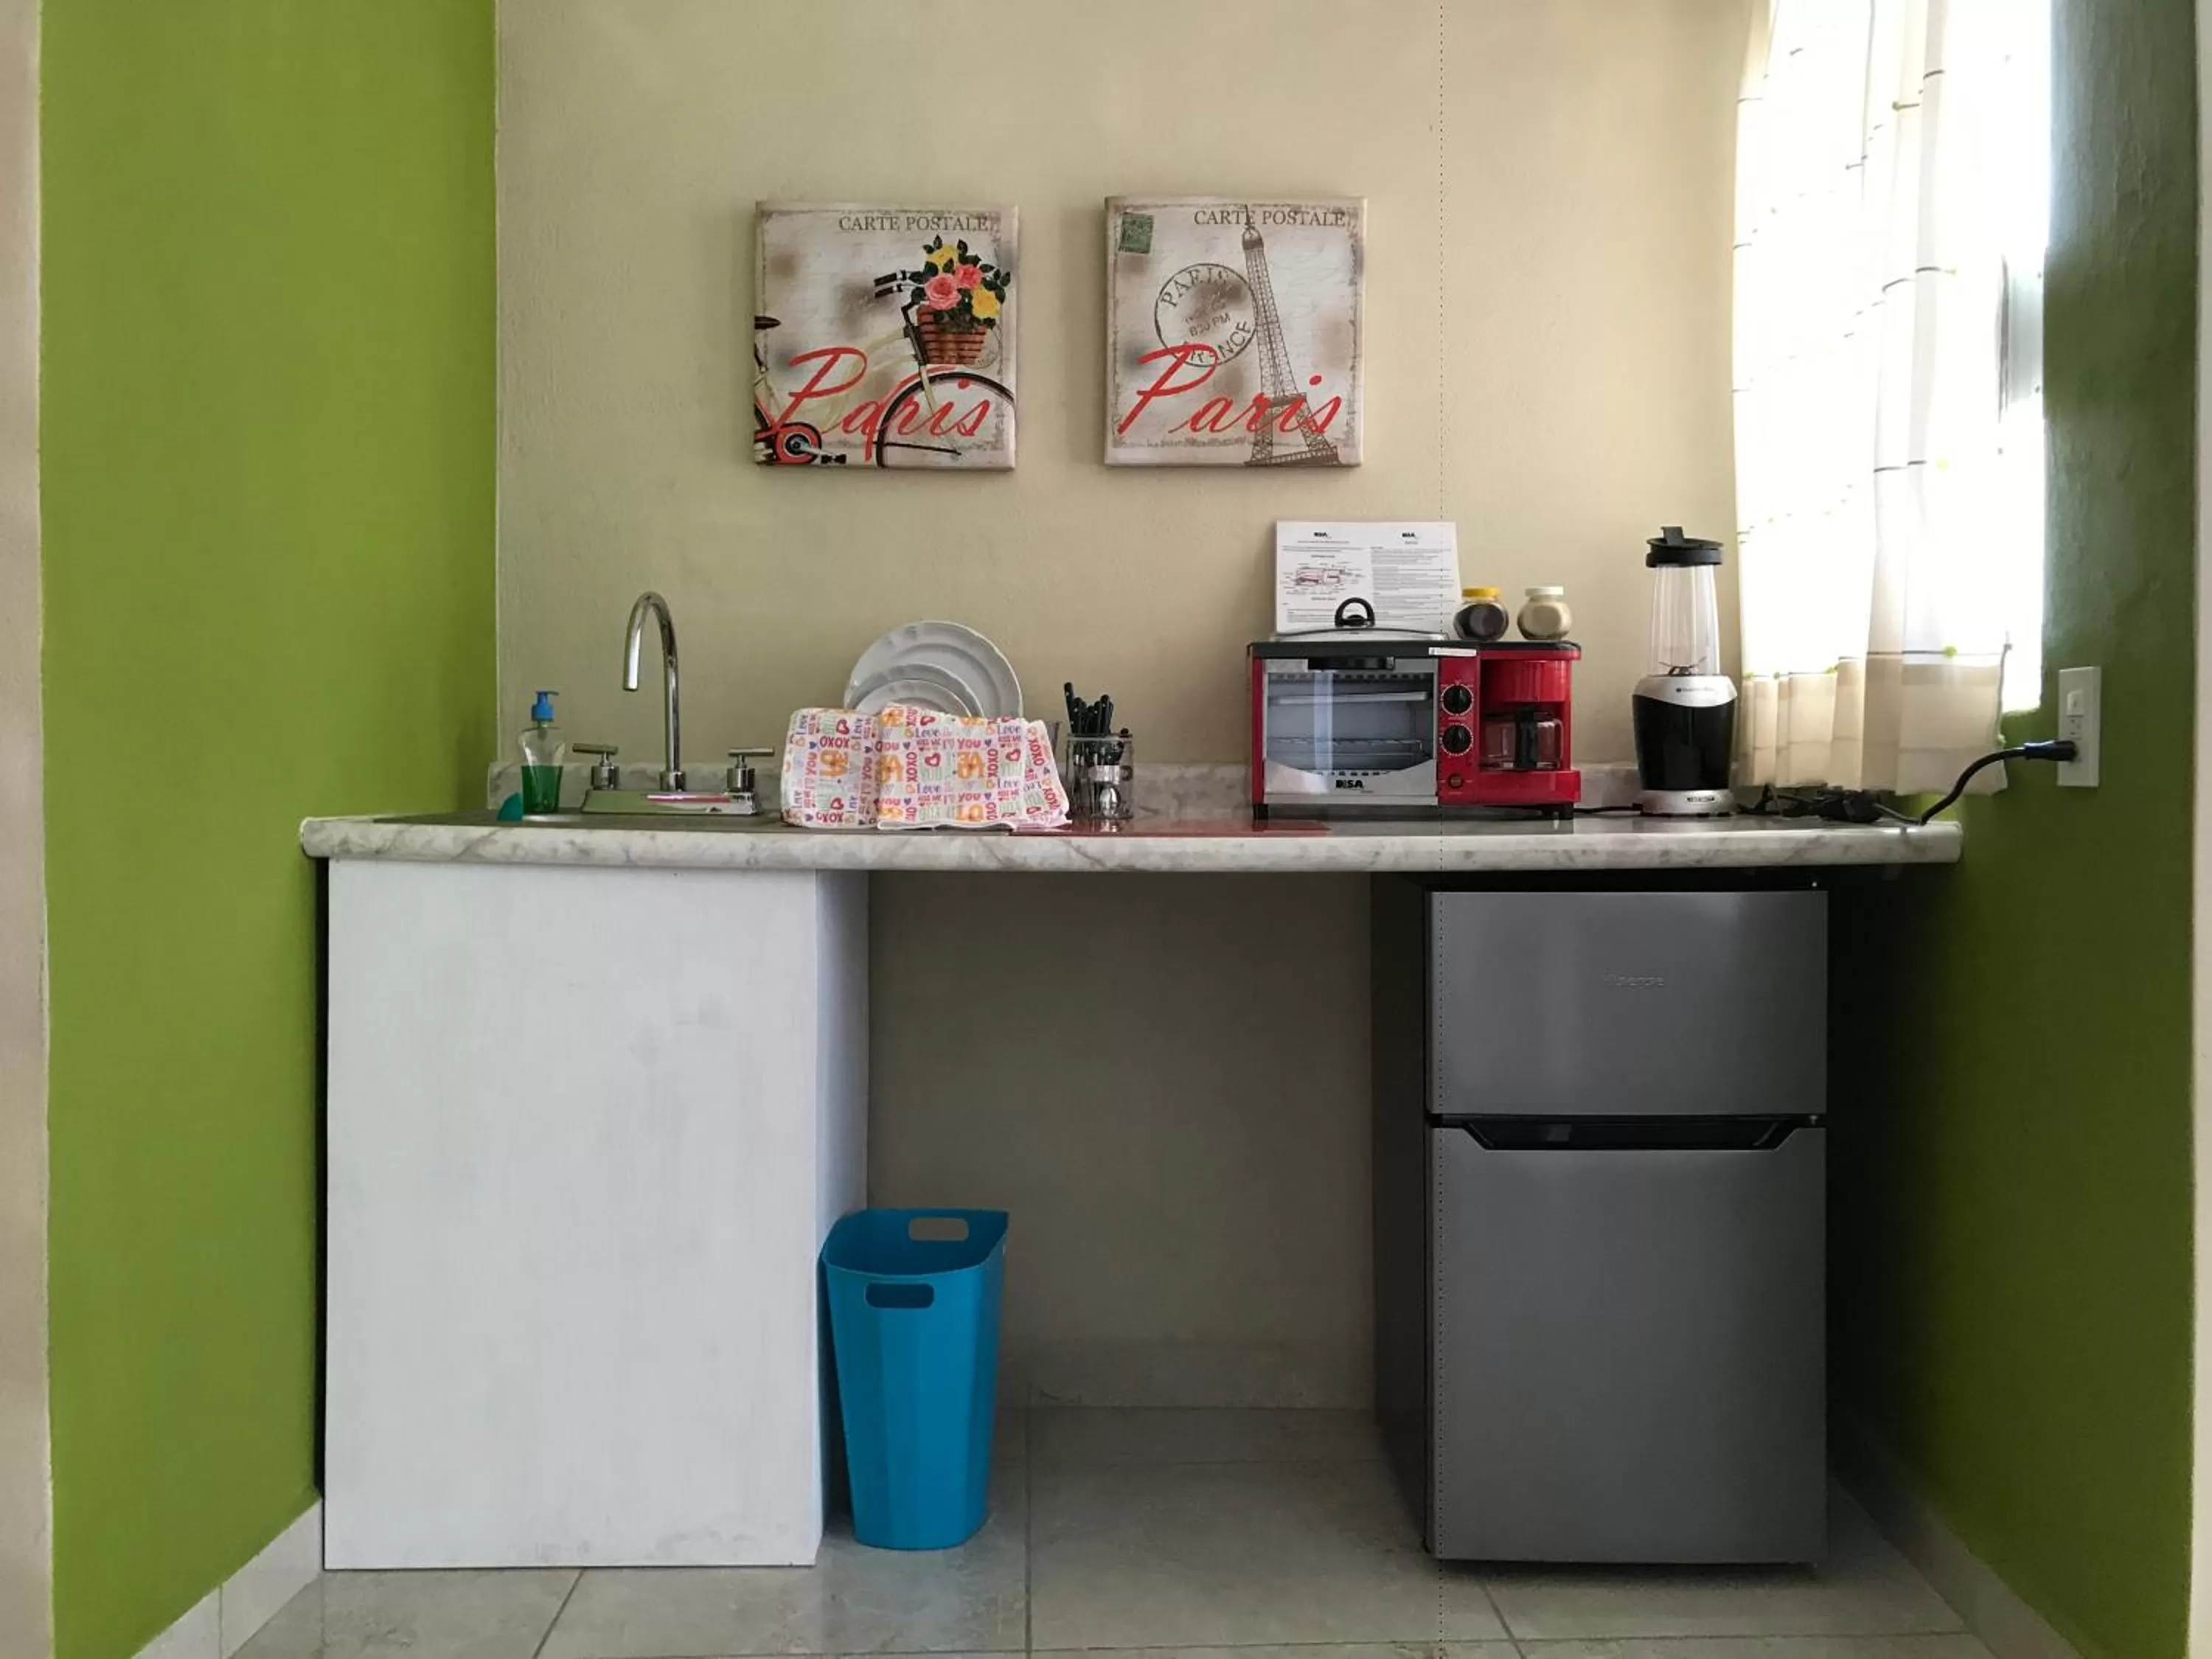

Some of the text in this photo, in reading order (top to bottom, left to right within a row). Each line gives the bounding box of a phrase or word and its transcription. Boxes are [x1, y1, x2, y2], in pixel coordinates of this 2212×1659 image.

[838, 216, 989, 232] CARTE POSTALE
[1194, 210, 1346, 227] CARTE POSTALE
[776, 346, 991, 437] Paris
[1117, 344, 1342, 434] Paris
